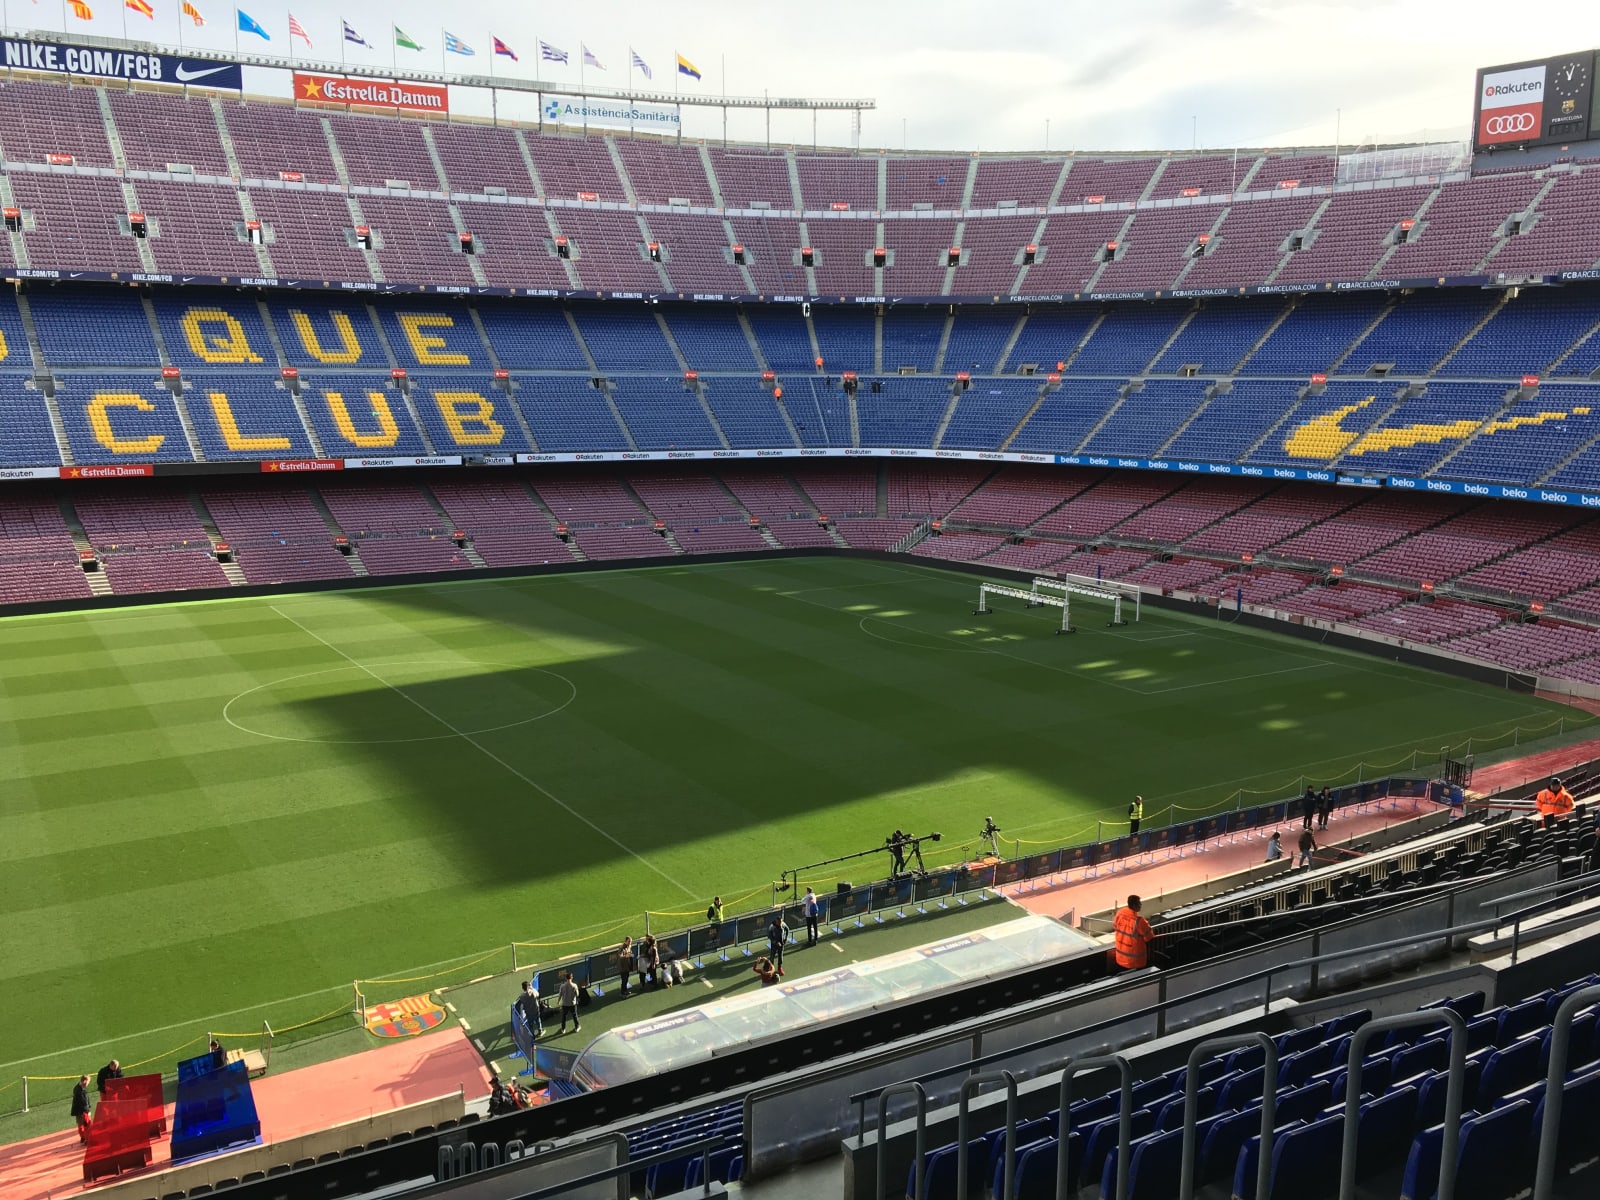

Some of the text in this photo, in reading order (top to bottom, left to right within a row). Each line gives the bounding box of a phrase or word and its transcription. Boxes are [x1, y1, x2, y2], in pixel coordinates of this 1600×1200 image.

[5, 42, 162, 79] NIKE.COM/FCB
[1495, 81, 1541, 96] Rakuten
[323, 80, 442, 107] Estrella Damm
[564, 104, 680, 123] Assistència Sanitària
[16, 269, 59, 278] NIKE.COM/FCB
[132, 273, 173, 282] NIKE.COM/FCB
[241, 278, 278, 286] NIKE.COM/FCB
[342, 282, 377, 290] NIKE.COM/FCB
[1337, 279, 1400, 289] FCBARCELONA.COM
[1172, 288, 1228, 297] FCBARCELONA.COM
[1257, 284, 1317, 293] FCBARCELONA.COM
[181, 309, 471, 365] QUE
[86, 391, 505, 454] CLUB
[1060, 456, 1080, 464] beko
[1090, 458, 1109, 466] beko
[1118, 459, 1139, 467] beko
[1148, 460, 1169, 469] beko
[280, 461, 335, 470] Estrella Damm
[1179, 462, 1200, 471] beko
[1210, 464, 1231, 473] beko
[1, 470, 34, 479] Rakuten
[81, 467, 144, 476] Estrella Damm
[1242, 466, 1263, 476] beko
[1274, 468, 1295, 478] beko
[1306, 470, 1329, 481] beko
[1392, 477, 1415, 488] beko
[1427, 480, 1452, 491] beko
[1464, 483, 1489, 495] beko
[1502, 487, 1528, 498] beko
[1541, 491, 1568, 503] beko
